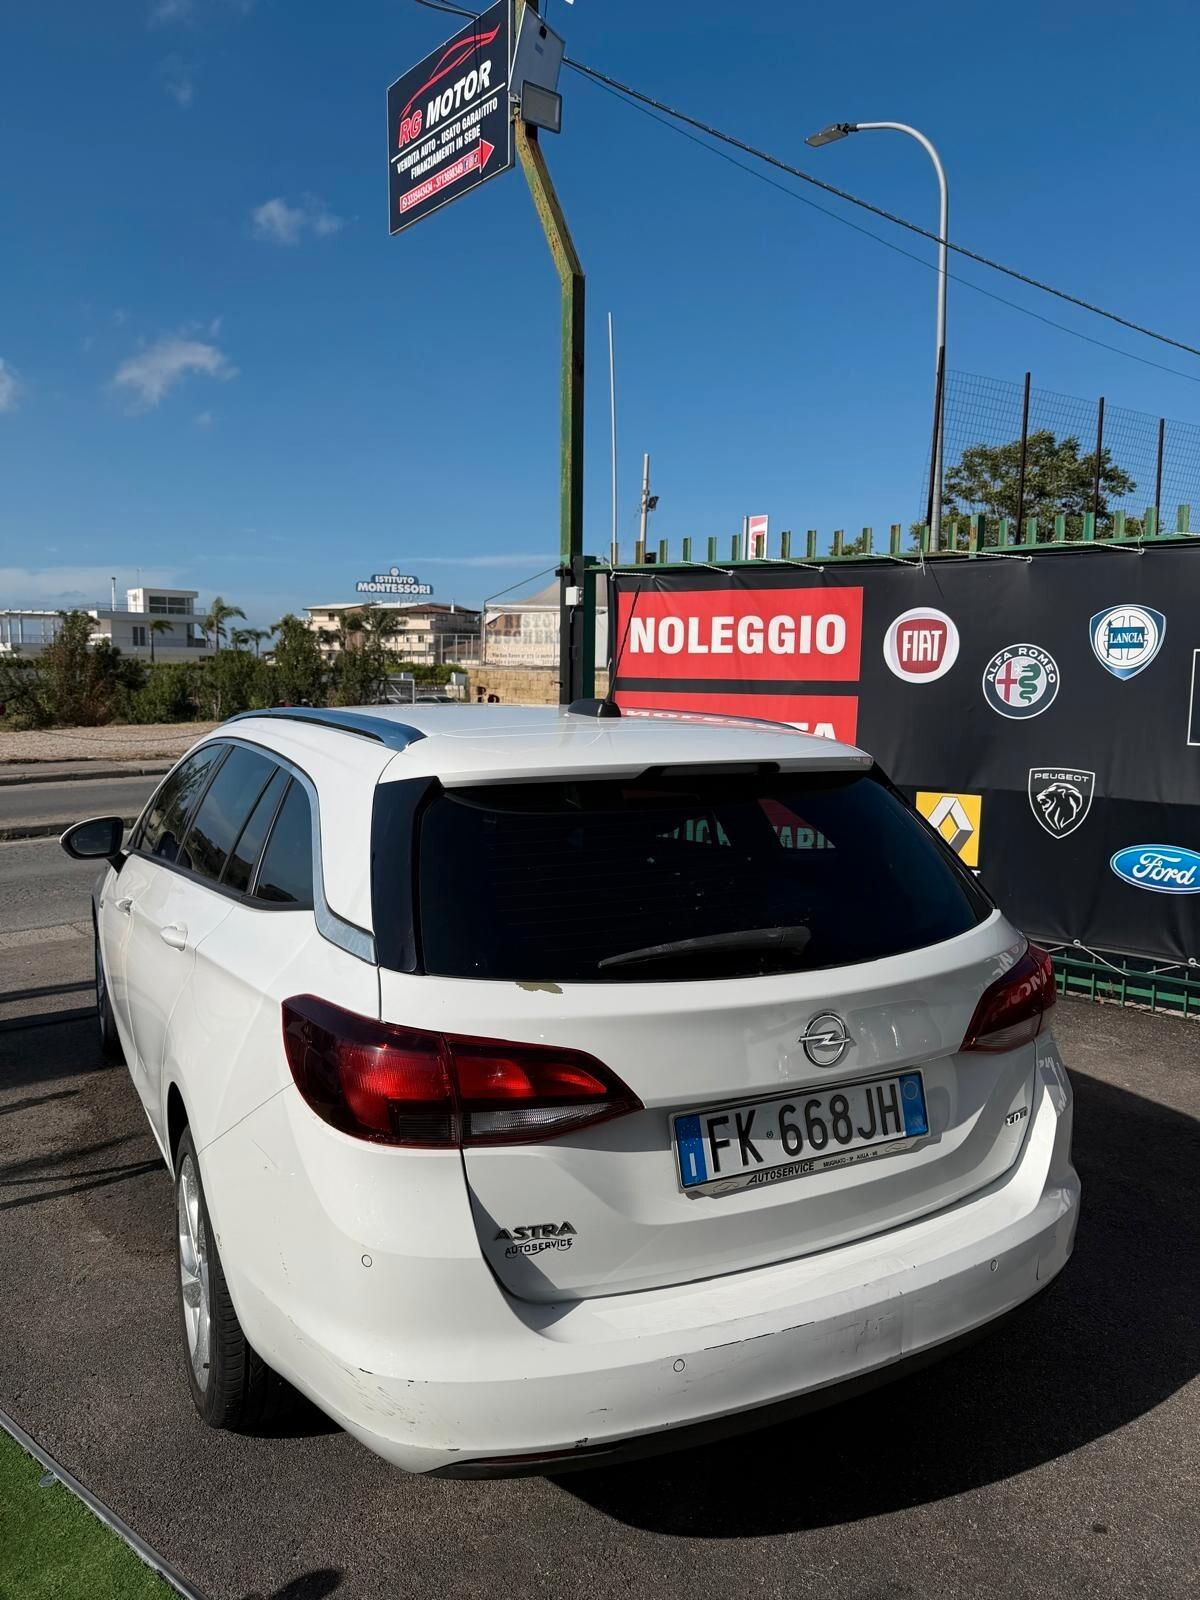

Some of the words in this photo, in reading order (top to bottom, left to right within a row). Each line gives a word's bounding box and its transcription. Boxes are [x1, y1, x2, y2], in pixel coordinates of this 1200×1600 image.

[399, 110, 422, 148] RG
[426, 60, 491, 128] MOTOR
[397, 150, 420, 174] VENDITA
[421, 139, 436, 158] AUTO
[441, 121, 460, 144] USATO
[462, 97, 498, 130] GARANTITO
[411, 140, 455, 180] FINANZIAMENTI
[456, 135, 463, 149] IN
[464, 125, 480, 145] SEDE
[357, 582, 431, 594] MONTESSORI
[375, 576, 415, 584] ISTITUTO
[629, 613, 847, 655] NOLEGGIO
[902, 630, 943, 662] FIAT
[1109, 632, 1144, 643] LANCIA
[987, 651, 1012, 683] ALFA
[1018, 647, 1056, 683] ROMEO
[1034, 773, 1089, 782] PEUGEOT
[1132, 852, 1198, 886] Ford
[706, 1109, 764, 1173] FK
[746, 1161, 815, 1185] AUTOSERVICE
[494, 1221, 578, 1241] ASTRA
[505, 1238, 573, 1255] AUTOSERVICE
